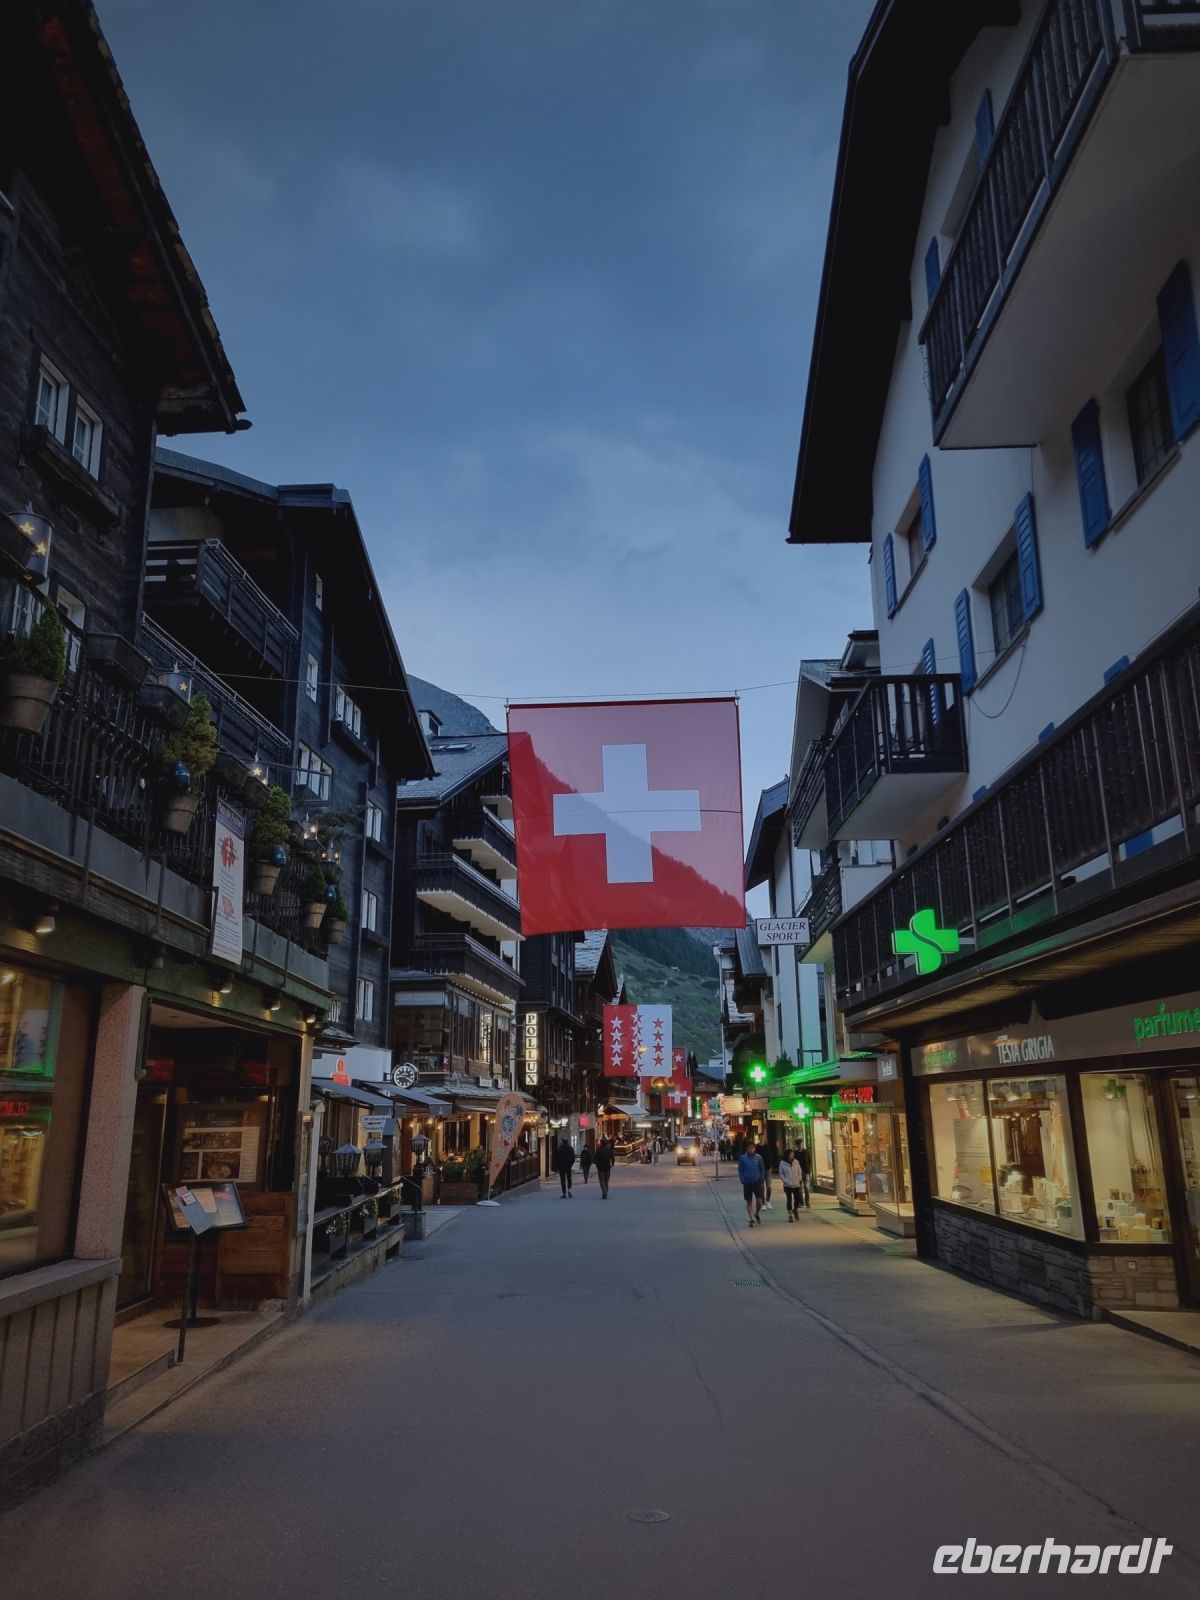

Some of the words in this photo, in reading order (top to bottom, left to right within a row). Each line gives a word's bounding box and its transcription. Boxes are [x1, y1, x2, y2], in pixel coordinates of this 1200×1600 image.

[759, 921, 806, 931] GLACIER
[766, 932, 801, 941] SPORT
[526, 1014, 537, 1085] POLLUX
[1021, 1035, 1056, 1061] GRIGIA
